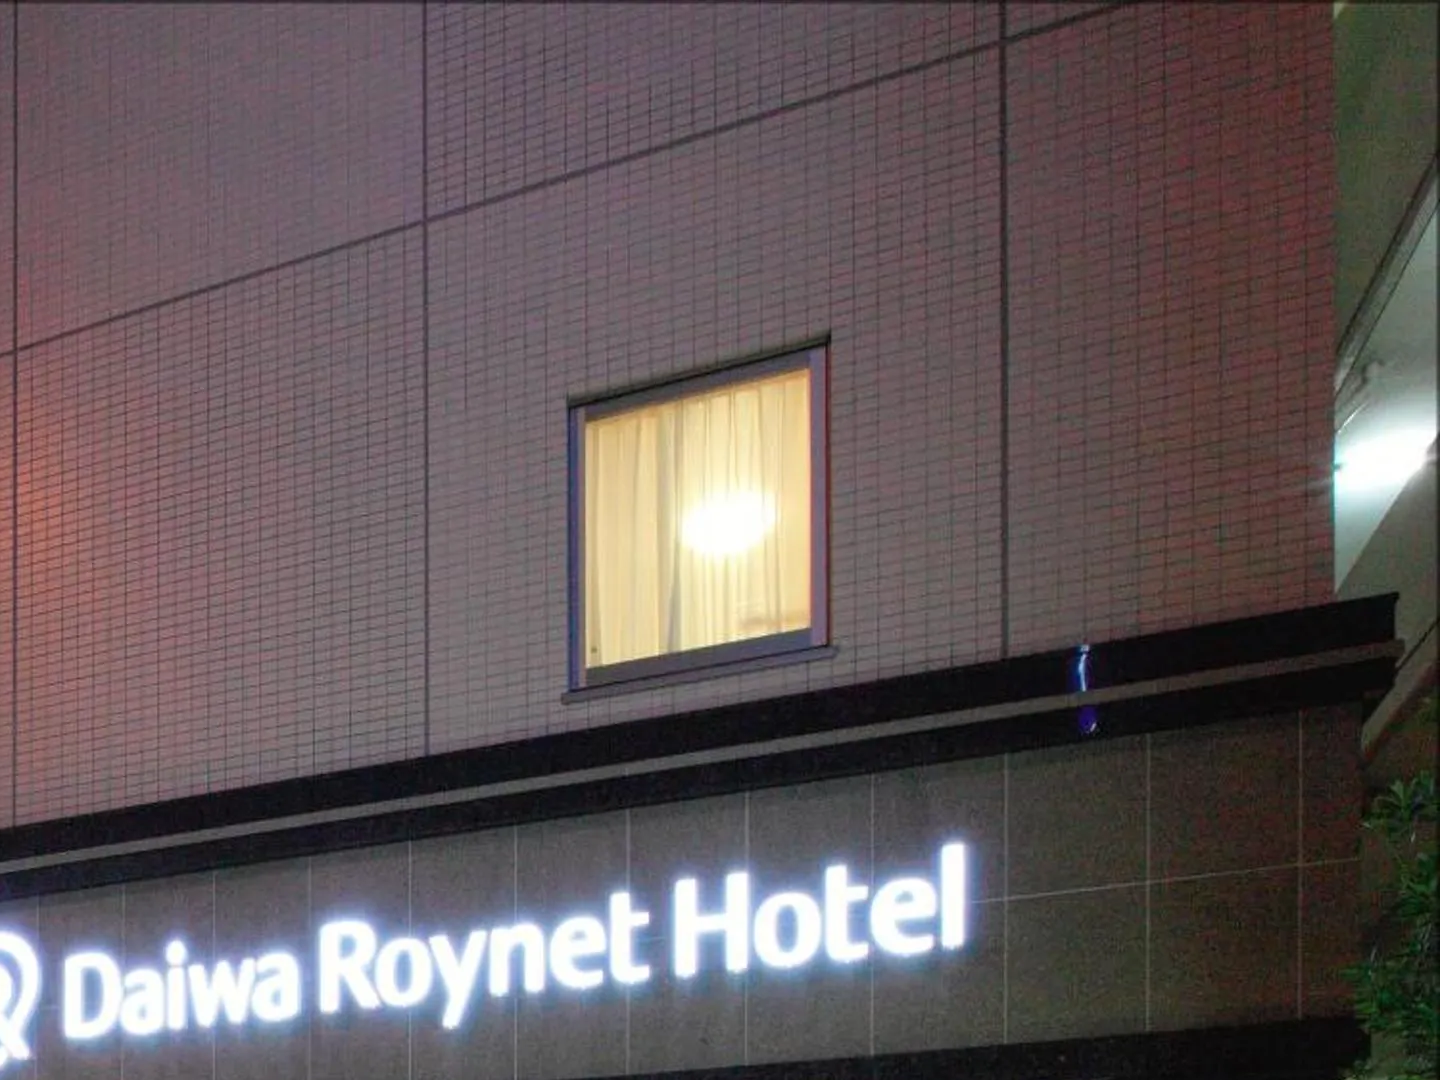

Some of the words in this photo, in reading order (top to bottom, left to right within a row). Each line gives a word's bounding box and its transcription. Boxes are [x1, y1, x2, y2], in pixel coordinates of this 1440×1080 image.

[63, 940, 301, 1040] Daiwa
[318, 891, 650, 1029] Roynet
[674, 843, 966, 979] Hotel
